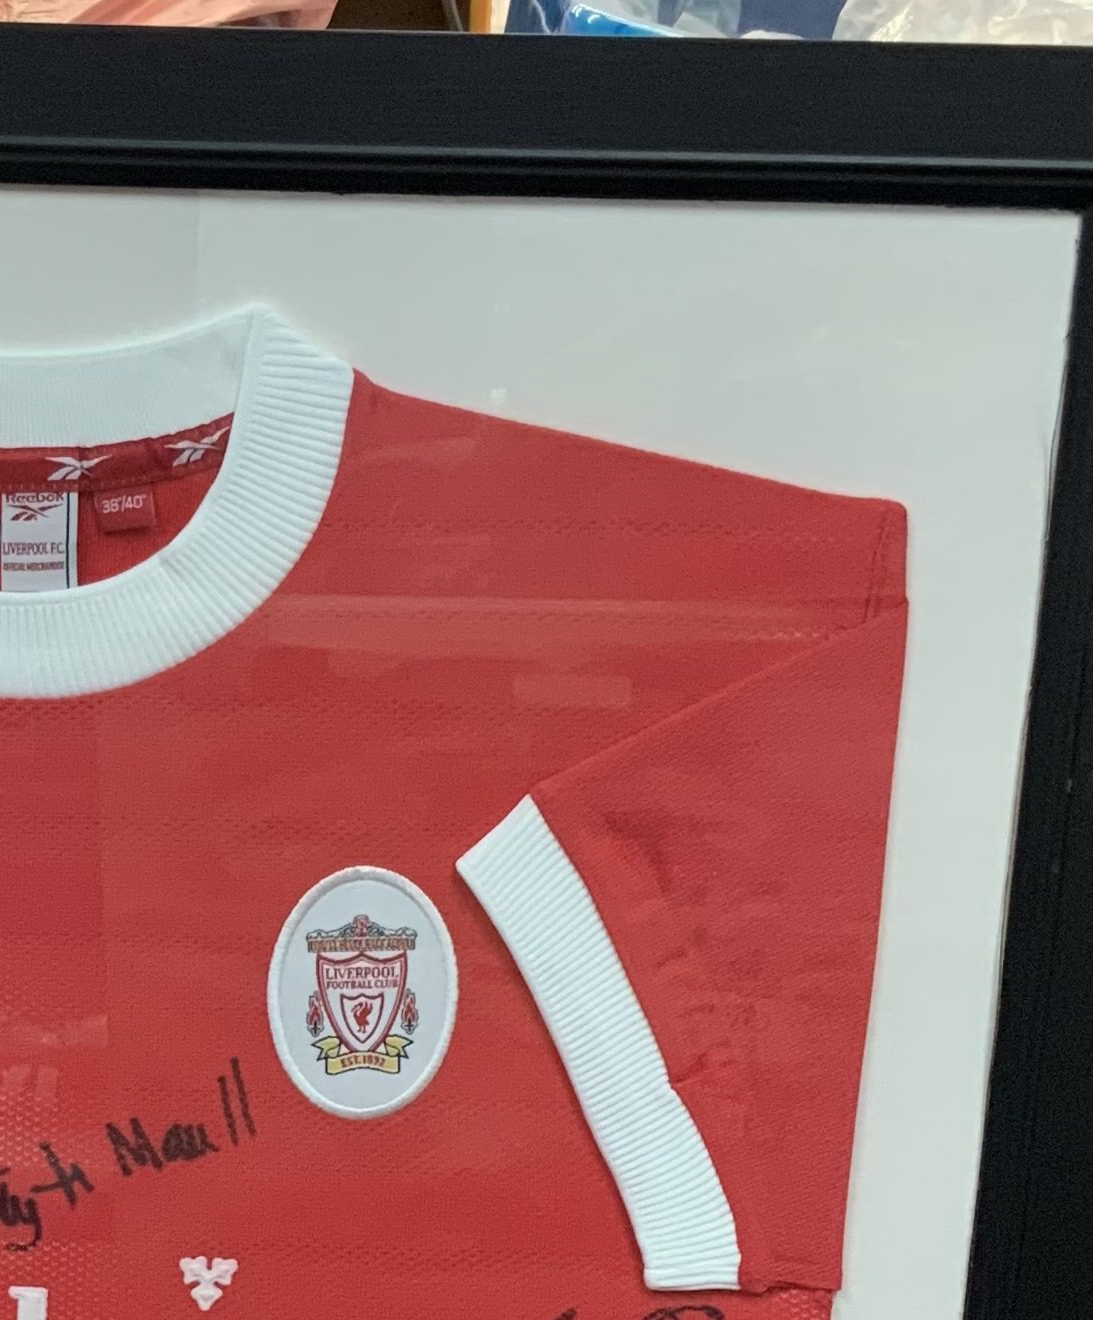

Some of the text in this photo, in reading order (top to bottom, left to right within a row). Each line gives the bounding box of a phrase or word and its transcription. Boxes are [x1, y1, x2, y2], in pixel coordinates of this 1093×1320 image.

[3, 542, 49, 556] LIVERPOOL
[325, 966, 399, 980] LIVERPOOL
[326, 979, 399, 990] FOOTBALL CLUB
